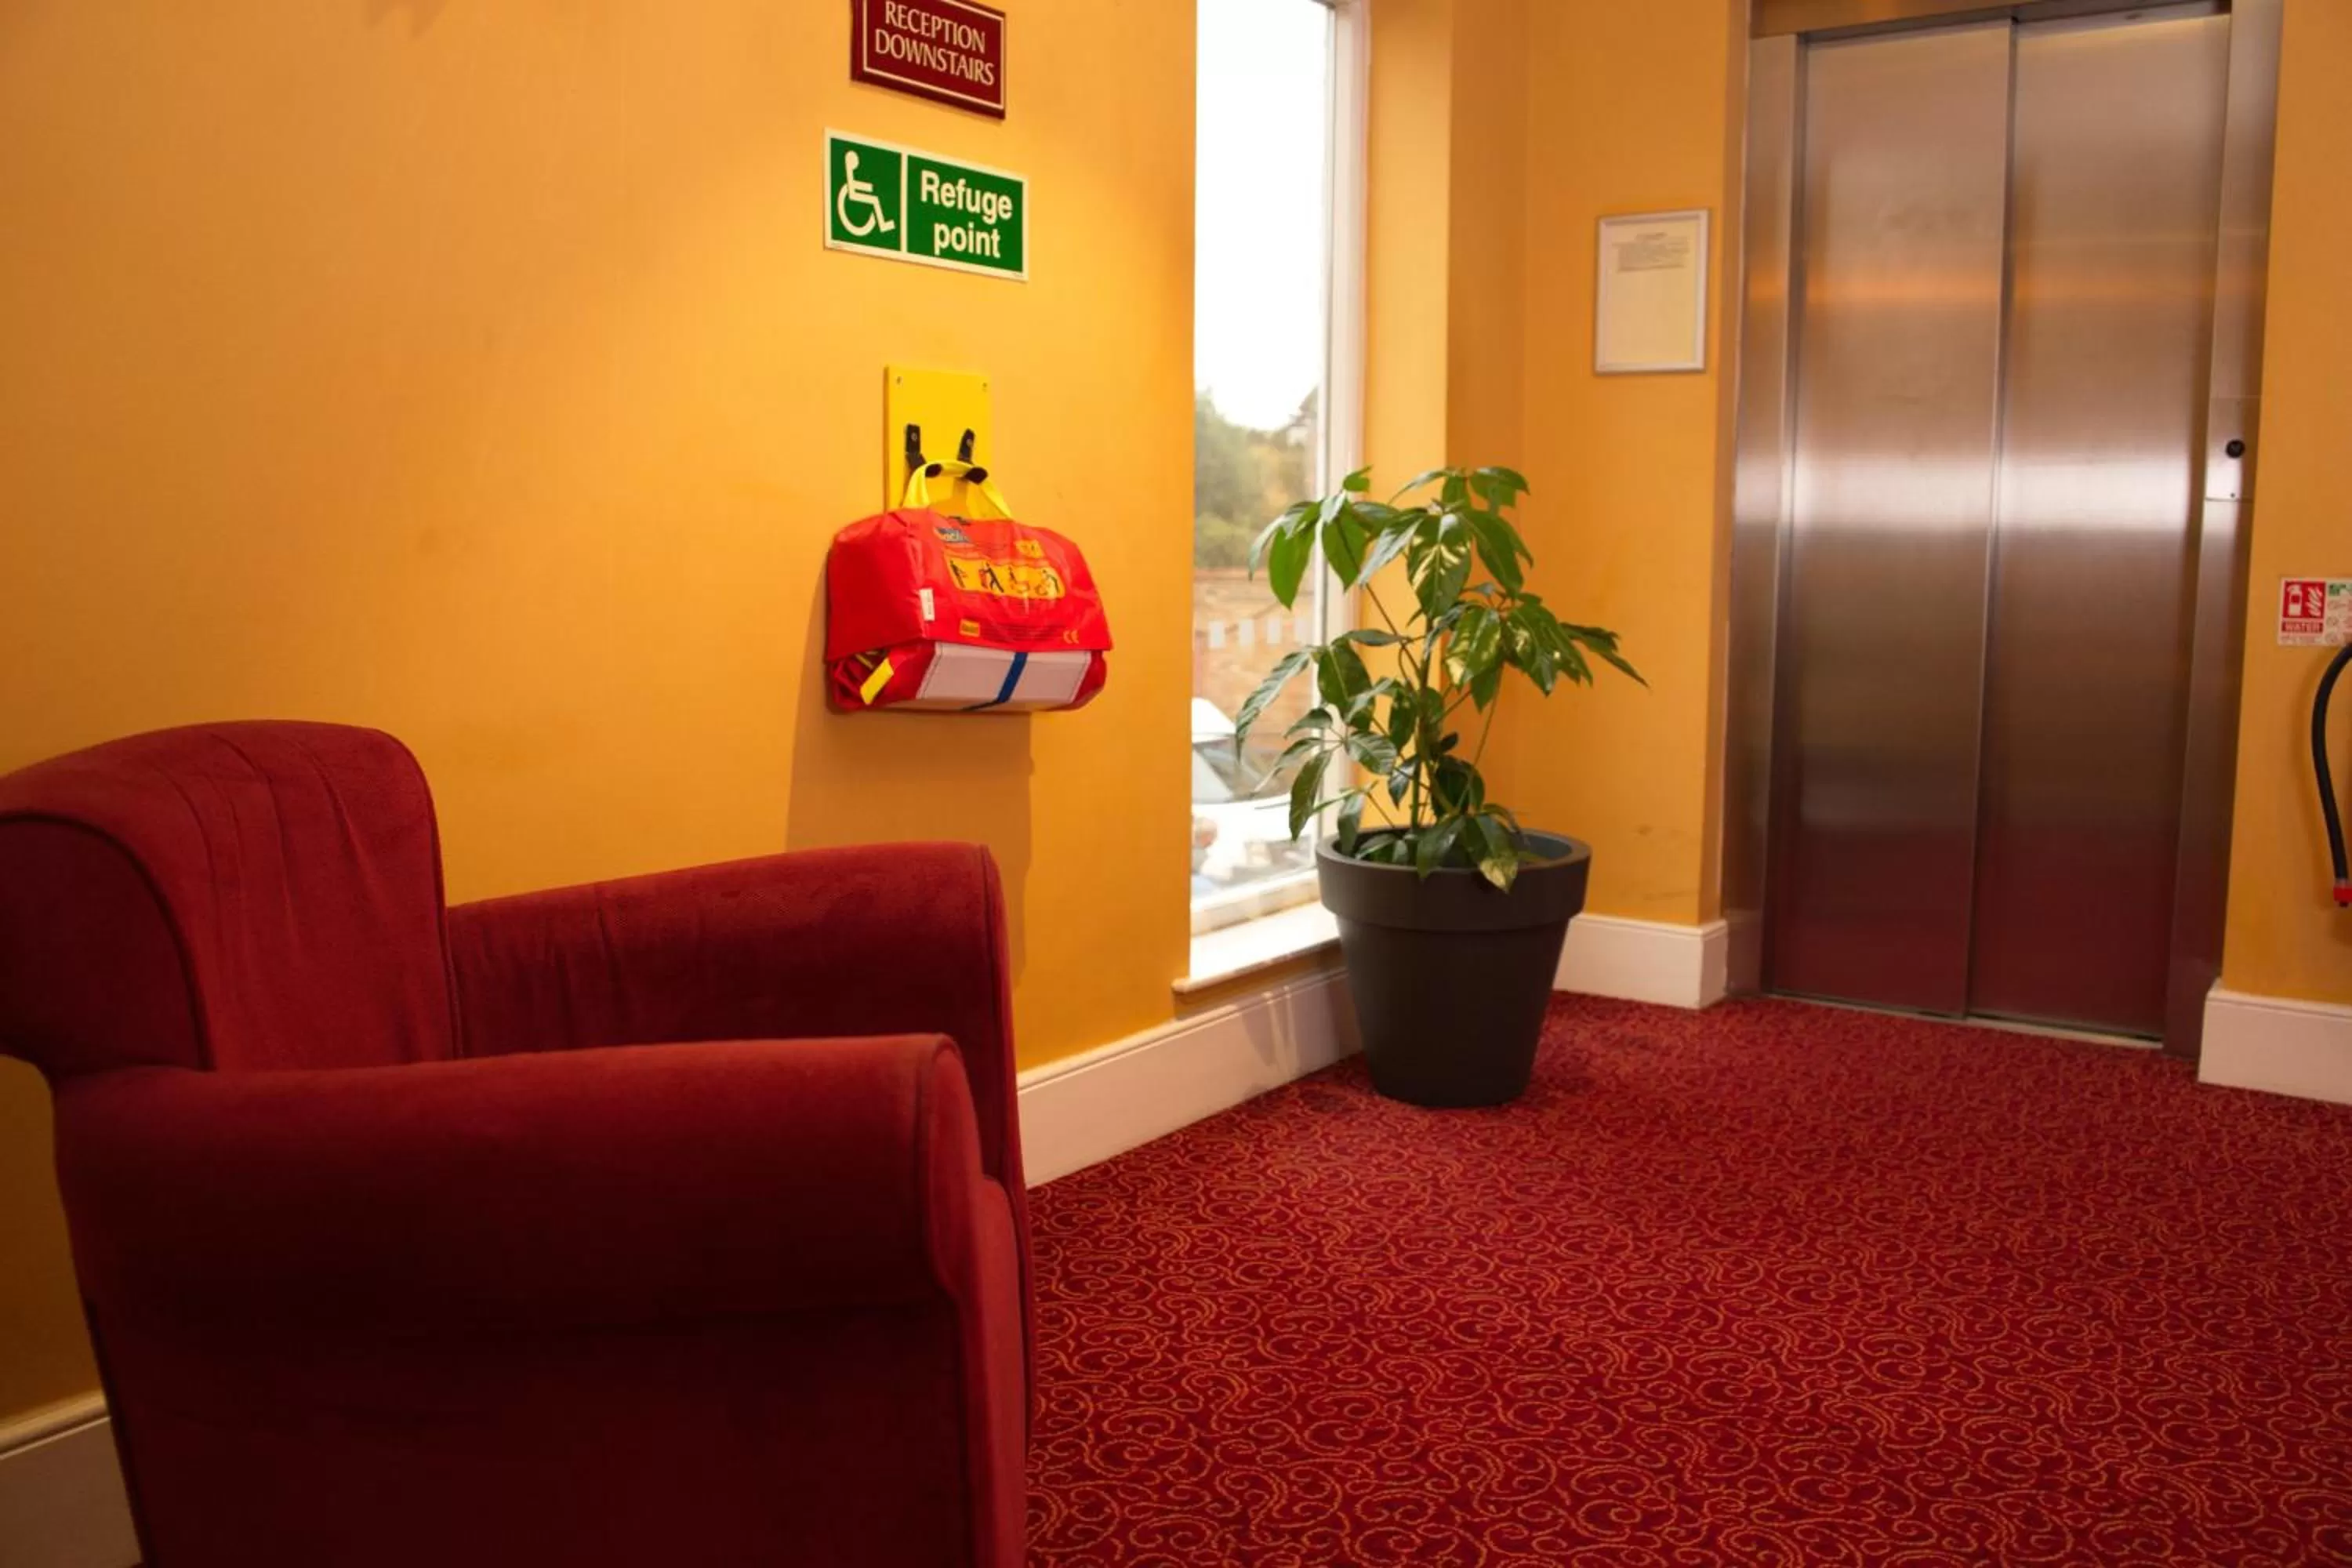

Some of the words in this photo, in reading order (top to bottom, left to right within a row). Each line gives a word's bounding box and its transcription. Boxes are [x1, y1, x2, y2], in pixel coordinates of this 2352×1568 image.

[885, 1, 985, 54] RECEPTION
[875, 28, 994, 85] DOWNSTAIRS
[920, 169, 1012, 224] Refuge
[934, 222, 1000, 258] point
